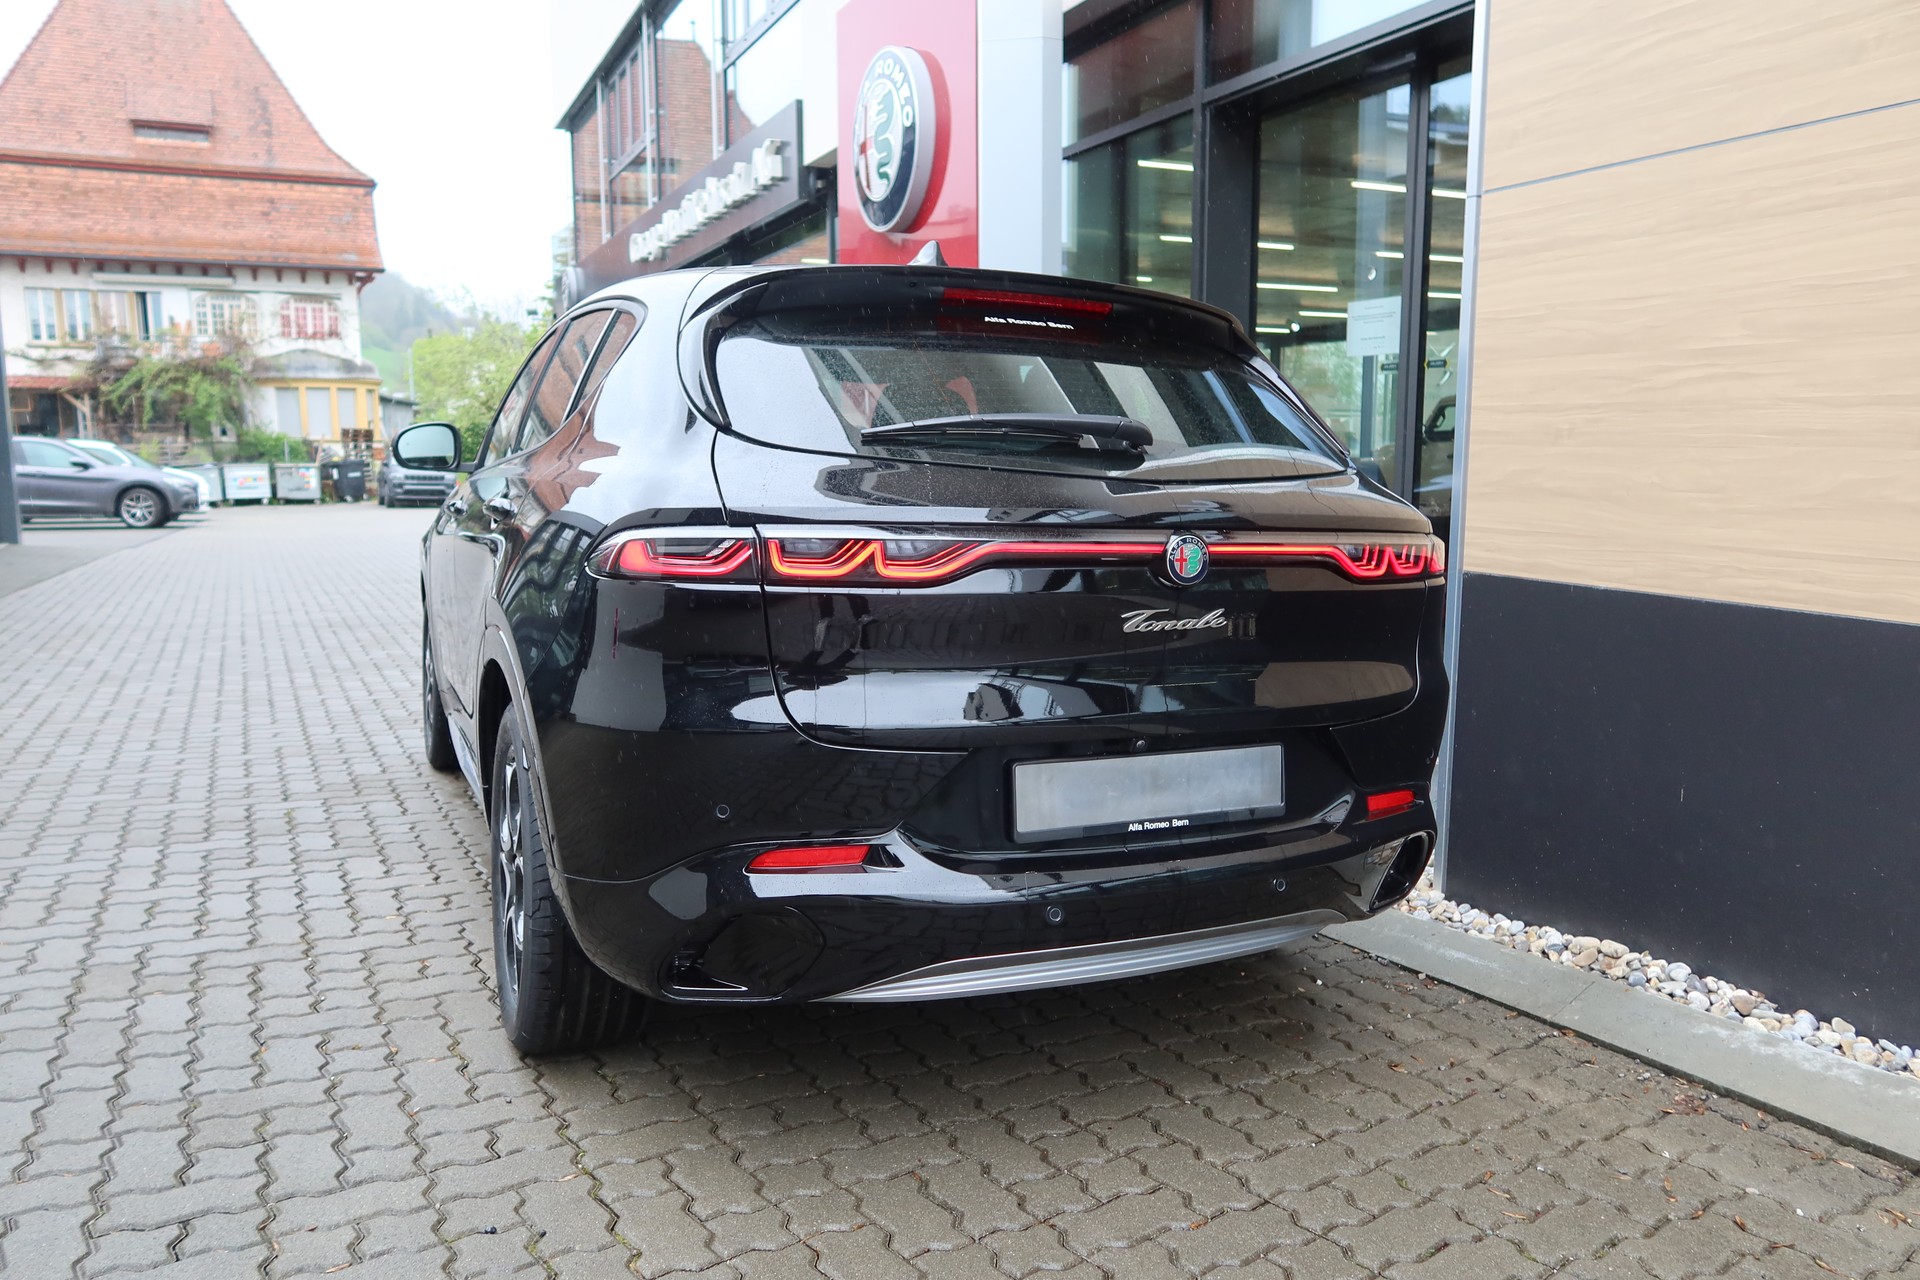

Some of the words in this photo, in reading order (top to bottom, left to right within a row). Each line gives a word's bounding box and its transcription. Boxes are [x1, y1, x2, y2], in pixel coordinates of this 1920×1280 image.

[874, 58, 913, 127] ROMEO
[984, 316, 1007, 324] Alfa
[1006, 317, 1047, 327] Romeo
[1169, 540, 1184, 561] ALFA
[1186, 537, 1208, 561] ROMEO
[1120, 608, 1227, 633] Tonale
[1127, 822, 1143, 832] Alfa
[1143, 821, 1170, 830] Romeo
[1172, 818, 1189, 828] Bern
